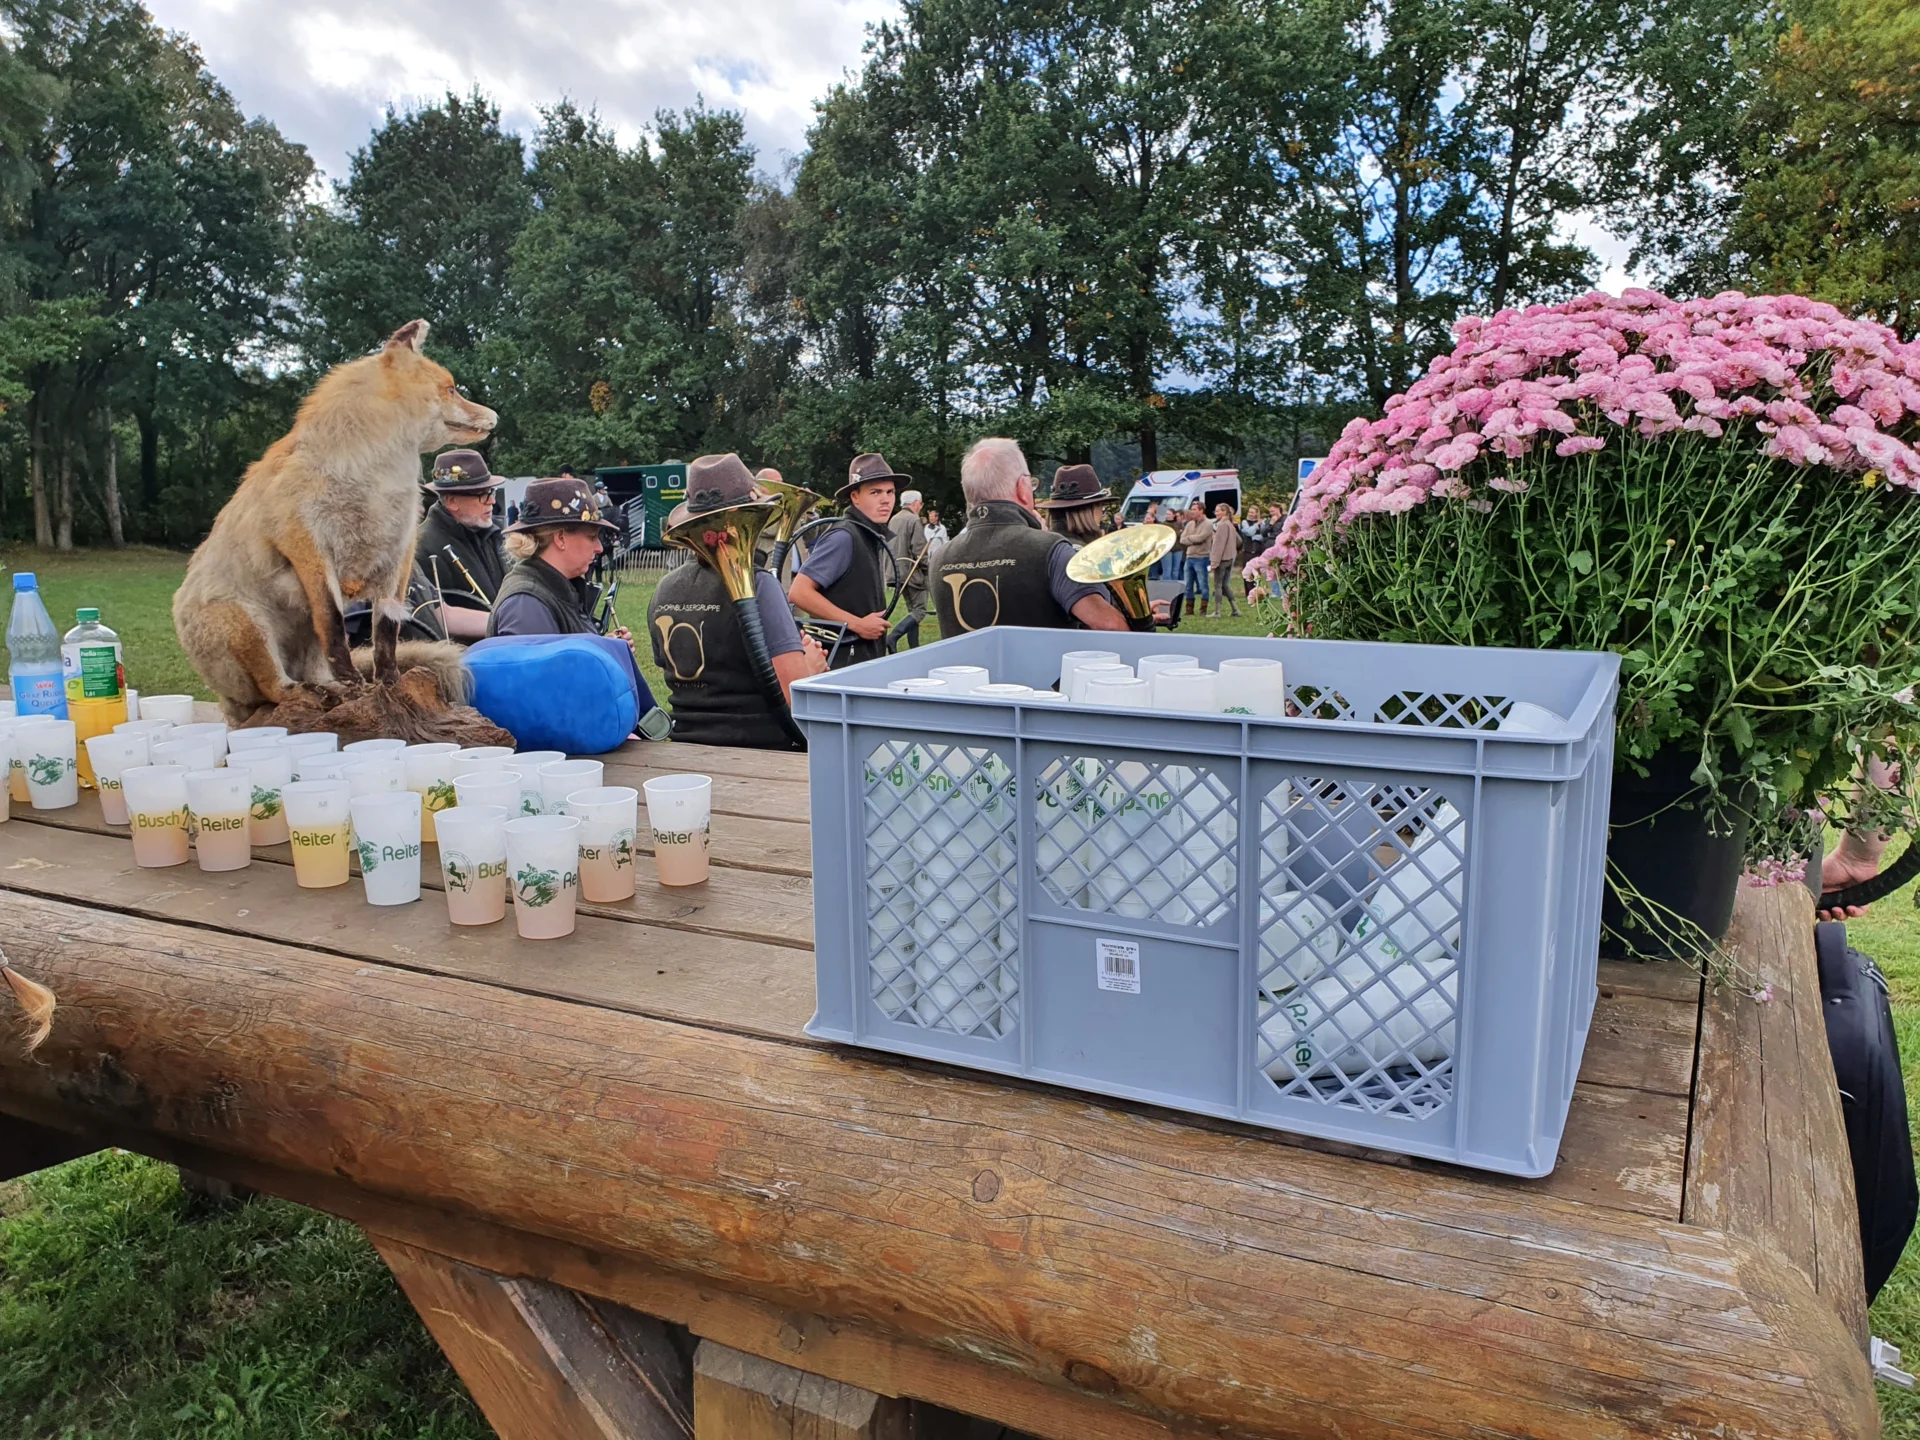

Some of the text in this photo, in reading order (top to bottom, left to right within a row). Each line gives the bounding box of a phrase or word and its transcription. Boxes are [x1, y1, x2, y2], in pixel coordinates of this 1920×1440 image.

[101, 777, 122, 790] Rei
[137, 811, 180, 829] Busch
[200, 816, 245, 832] Reiter
[292, 830, 336, 847] Reiter
[653, 827, 693, 845] Reiter
[382, 844, 420, 862] Reite
[579, 844, 601, 860] iter
[478, 860, 507, 880] Busc
